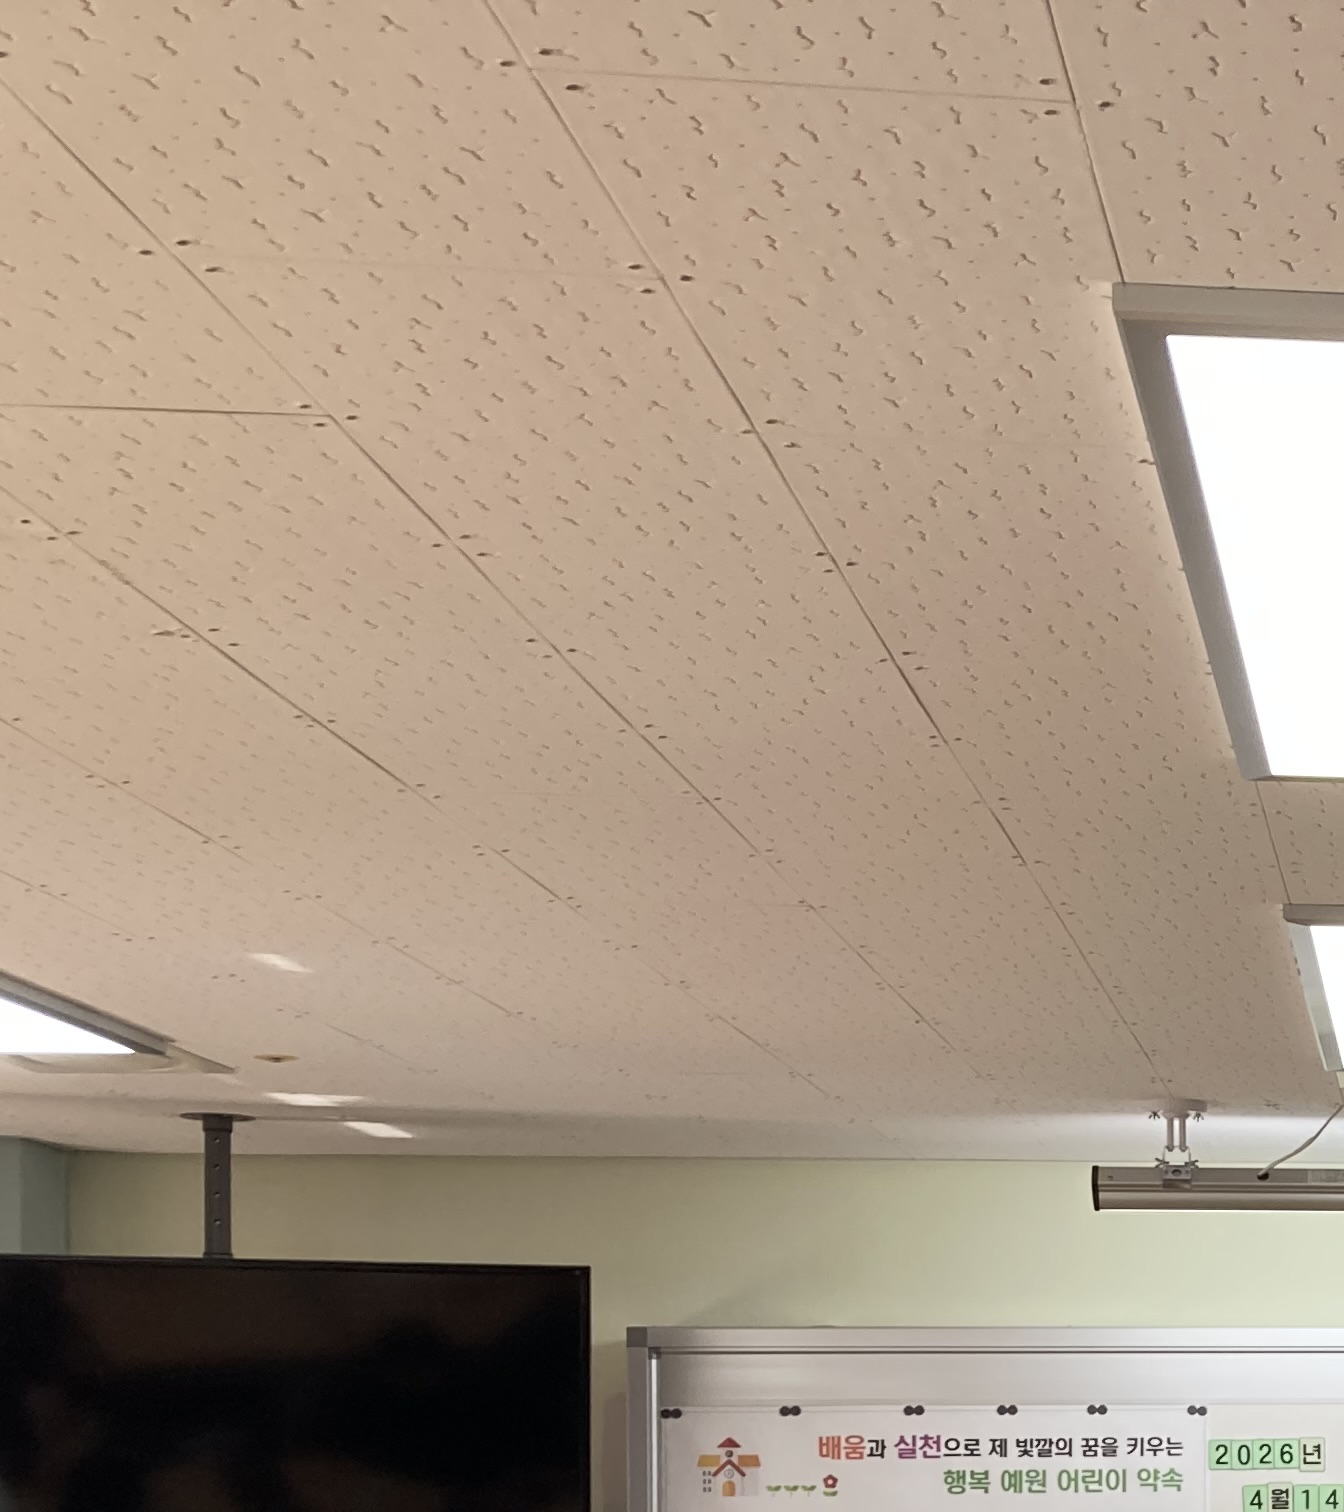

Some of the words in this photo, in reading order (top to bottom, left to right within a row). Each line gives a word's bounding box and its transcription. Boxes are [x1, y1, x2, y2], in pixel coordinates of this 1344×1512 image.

[818, 1434, 886, 1460] 배움과
[894, 1434, 981, 1460] 실천으로
[989, 1438, 1008, 1457] 제
[1015, 1437, 1073, 1457] 빛깔의
[1080, 1437, 1119, 1457] 꿈을
[1127, 1437, 1183, 1457] 키우는
[1215, 1443, 1321, 1465] 2026년
[944, 1469, 991, 1494] 행복
[1000, 1468, 1047, 1493] 예원
[1057, 1468, 1127, 1493] 어린이
[1137, 1467, 1183, 1492] 약속
